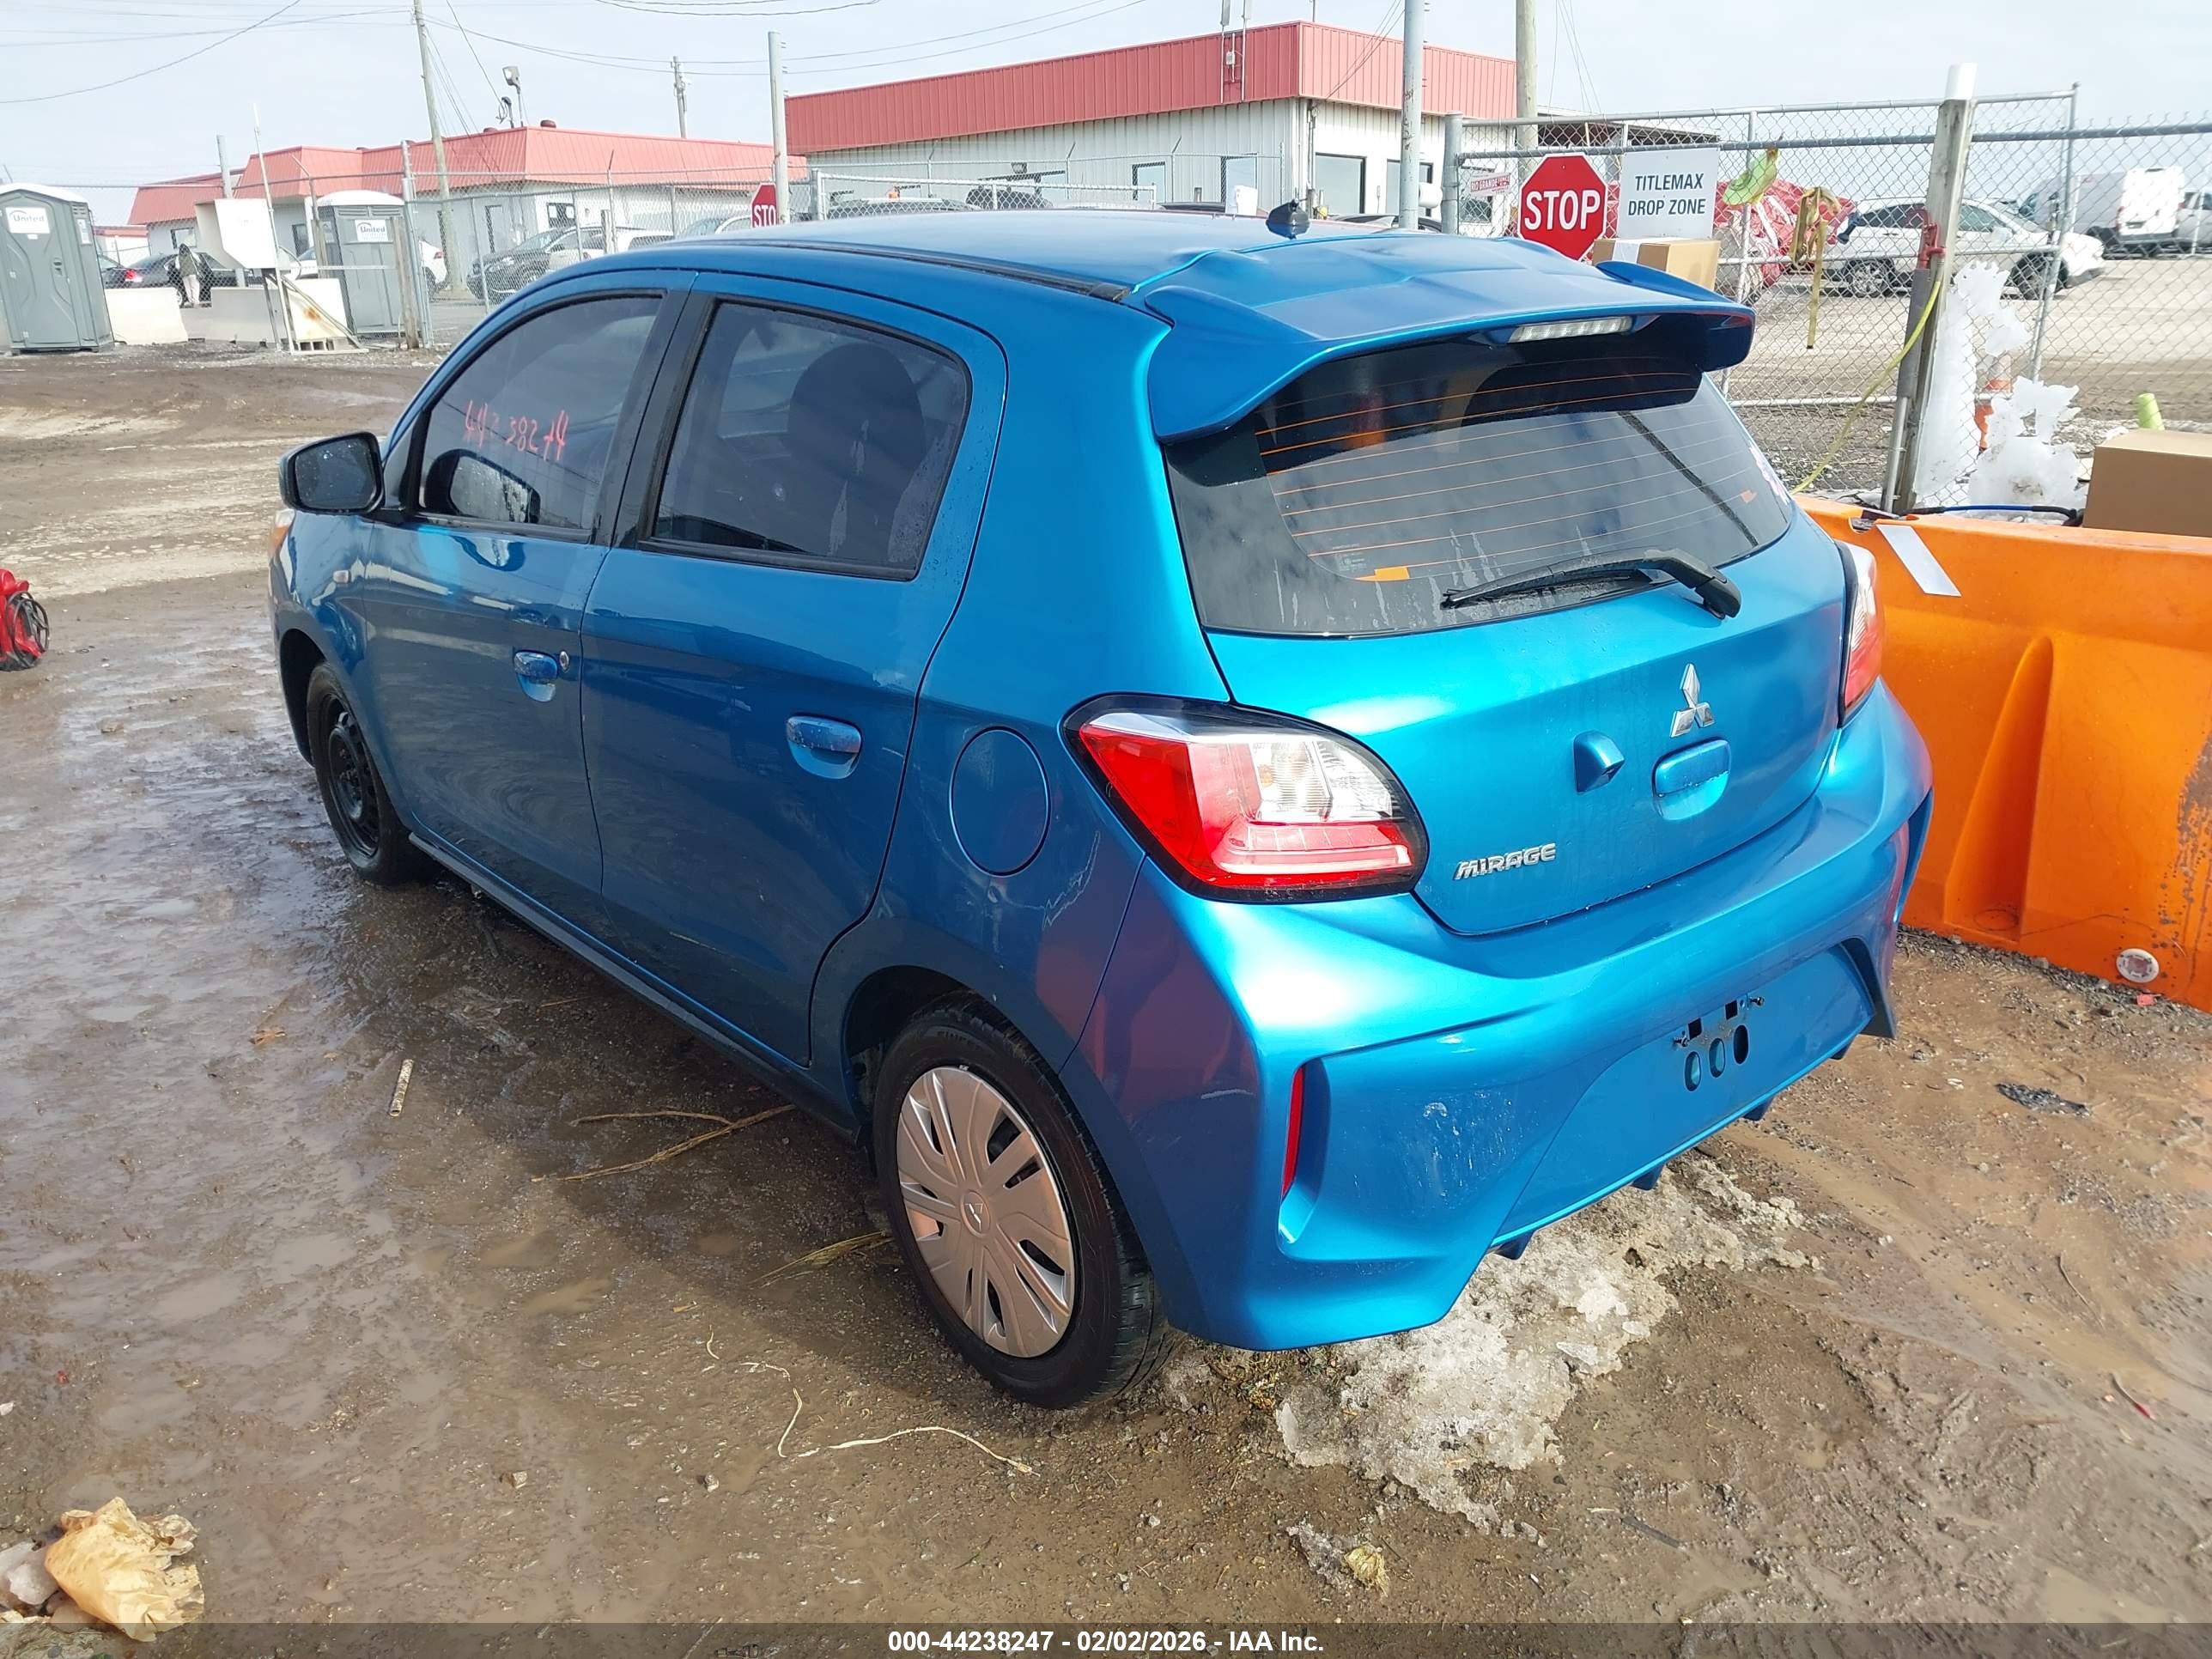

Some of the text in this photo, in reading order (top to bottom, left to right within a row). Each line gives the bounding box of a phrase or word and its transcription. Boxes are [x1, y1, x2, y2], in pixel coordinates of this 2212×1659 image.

[1634, 173, 1704, 191] TITLEMAX
[754, 204, 776, 227] STO
[1523, 189, 1601, 231] STOP
[1627, 198, 1706, 216] DROP ZONE
[13, 214, 45, 222] United
[1453, 842, 1557, 880] MIRAGE
